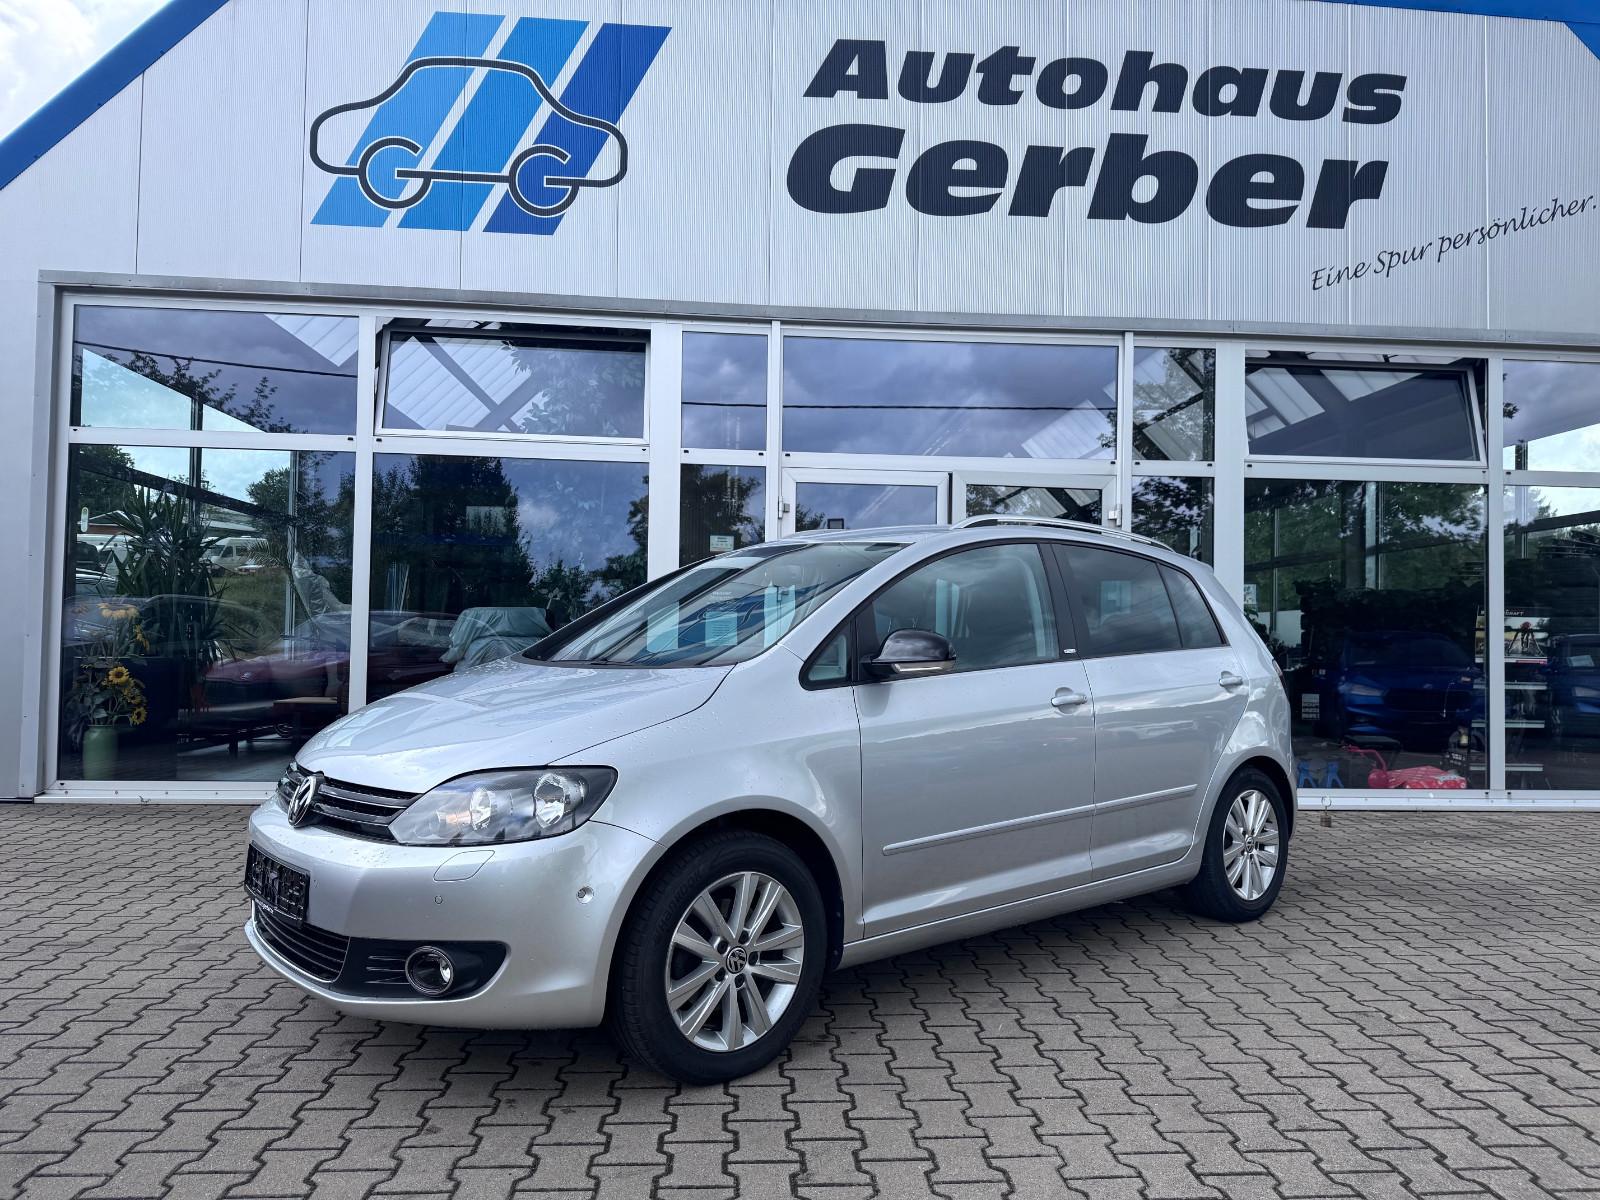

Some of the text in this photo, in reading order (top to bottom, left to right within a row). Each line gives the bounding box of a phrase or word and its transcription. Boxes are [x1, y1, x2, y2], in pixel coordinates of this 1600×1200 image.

[803, 39, 1407, 124] Autohaus
[787, 124, 1389, 229] Gerber
[1311, 195, 1597, 291] Eine Spur persönlicher.
